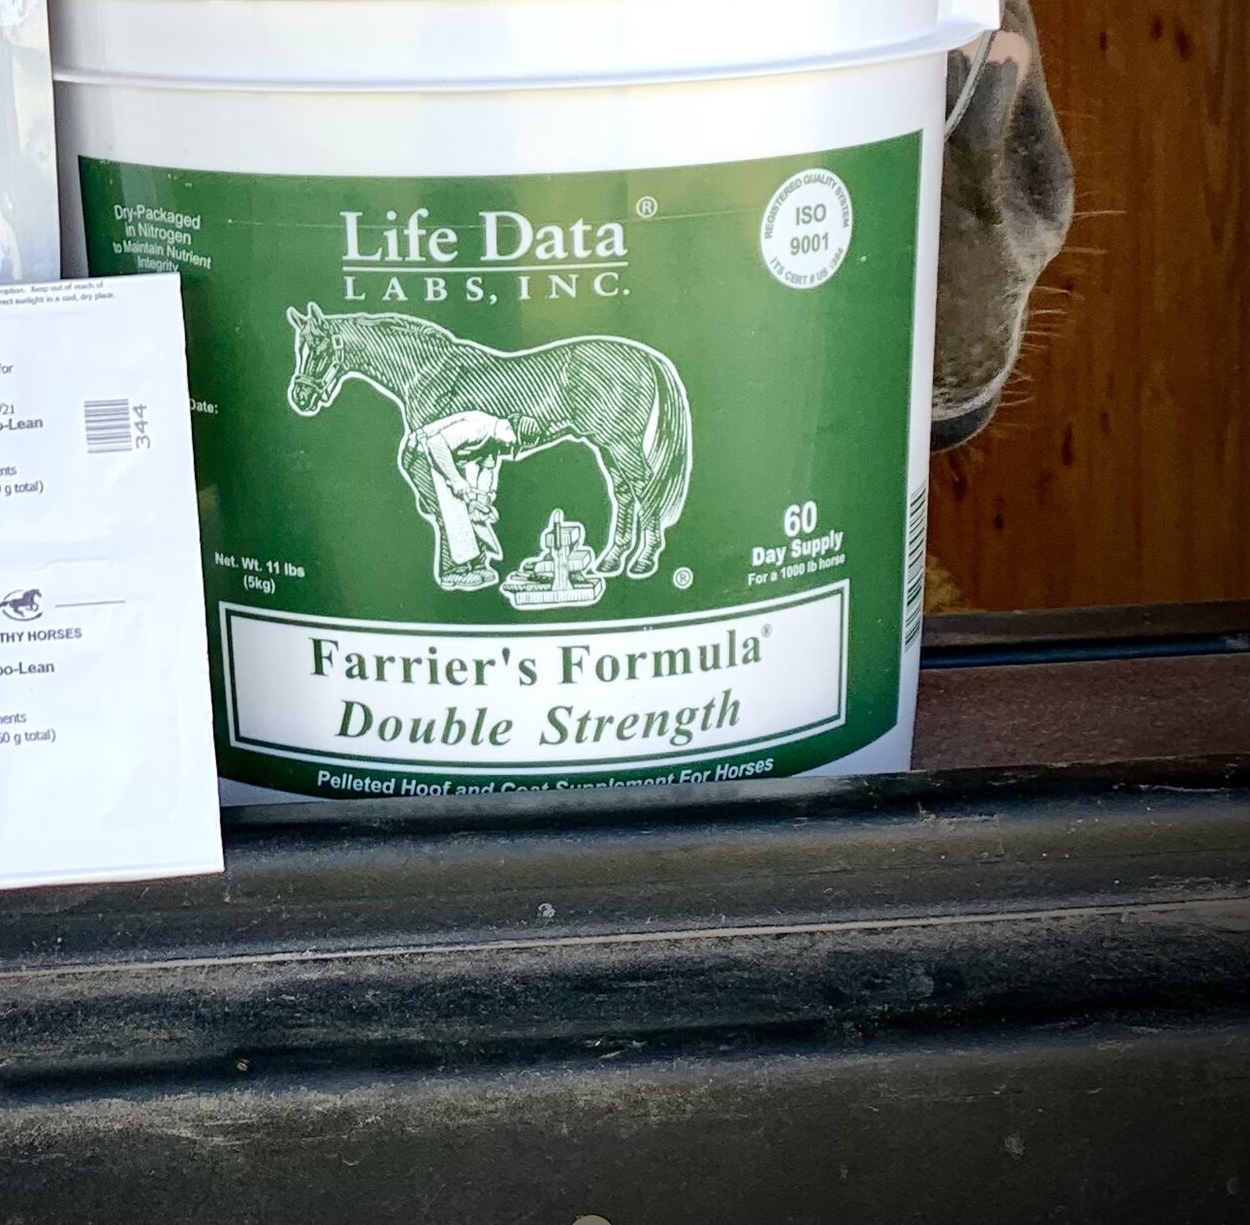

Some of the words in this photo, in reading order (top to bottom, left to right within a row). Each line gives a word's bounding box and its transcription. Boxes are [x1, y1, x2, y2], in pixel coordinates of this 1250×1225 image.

[803, 173, 838, 189] QUALITY
[114, 204, 201, 230] Dry-Packaged
[764, 178, 802, 239] REGISTERED
[796, 203, 827, 226] ISO
[835, 186, 850, 228] SYSTEM
[125, 222, 136, 237] in
[138, 222, 192, 245] Nitrogen
[340, 208, 458, 262] Life
[478, 210, 629, 261] Data
[790, 231, 829, 256] 9001
[113, 241, 123, 254] to
[123, 240, 164, 256] Maintain
[166, 244, 212, 269] Nutrient
[137, 255, 179, 272] Integrity
[134, 403, 151, 450] 344
[5, 485, 12, 496] g
[14, 480, 44, 494] total)
[784, 501, 818, 537] 60
[752, 546, 786, 566] Day
[791, 530, 843, 558] Supply
[215, 552, 239, 568] Net.
[241, 557, 262, 572] Wt.
[266, 560, 280, 574] 11
[284, 562, 305, 578] lbs
[748, 573, 768, 586] For
[770, 572, 778, 582] a
[781, 563, 805, 579] 1000
[807, 560, 817, 573] lb
[819, 554, 846, 570] horse
[243, 575, 275, 594] (5kg)
[27, 627, 82, 642] HORSES
[310, 637, 538, 687] Farrier's
[557, 629, 763, 686] Formula
[334, 699, 513, 747] Double
[538, 688, 741, 746] Strength
[14, 733, 21, 745] g
[24, 728, 56, 743] total)
[317, 770, 396, 795] Pelleted
[401, 778, 452, 796] Hoof
[679, 769, 712, 785] For
[715, 757, 774, 782] Horses
